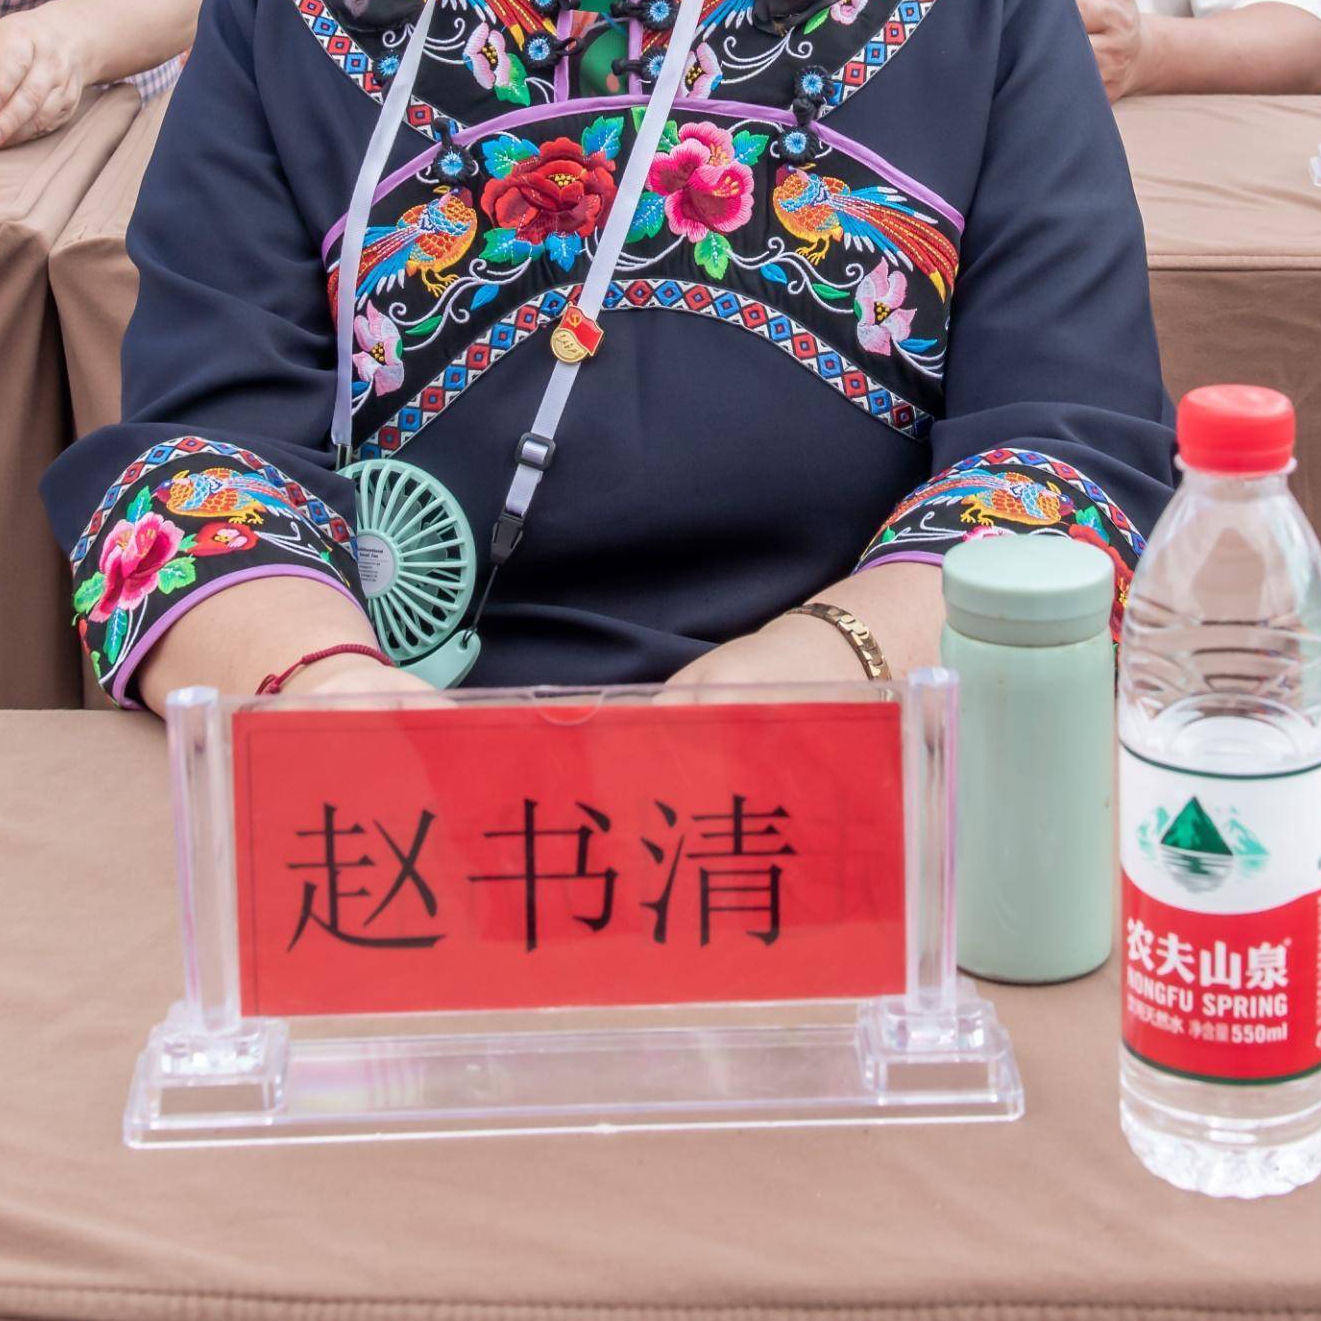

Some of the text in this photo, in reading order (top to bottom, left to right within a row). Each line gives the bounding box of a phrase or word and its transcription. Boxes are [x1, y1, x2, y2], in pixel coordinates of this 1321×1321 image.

[286, 794, 799, 953] 赵书清
[1127, 916, 1289, 990] 农夫山泉
[1127, 965, 1289, 1019] NONGFU SPRING
